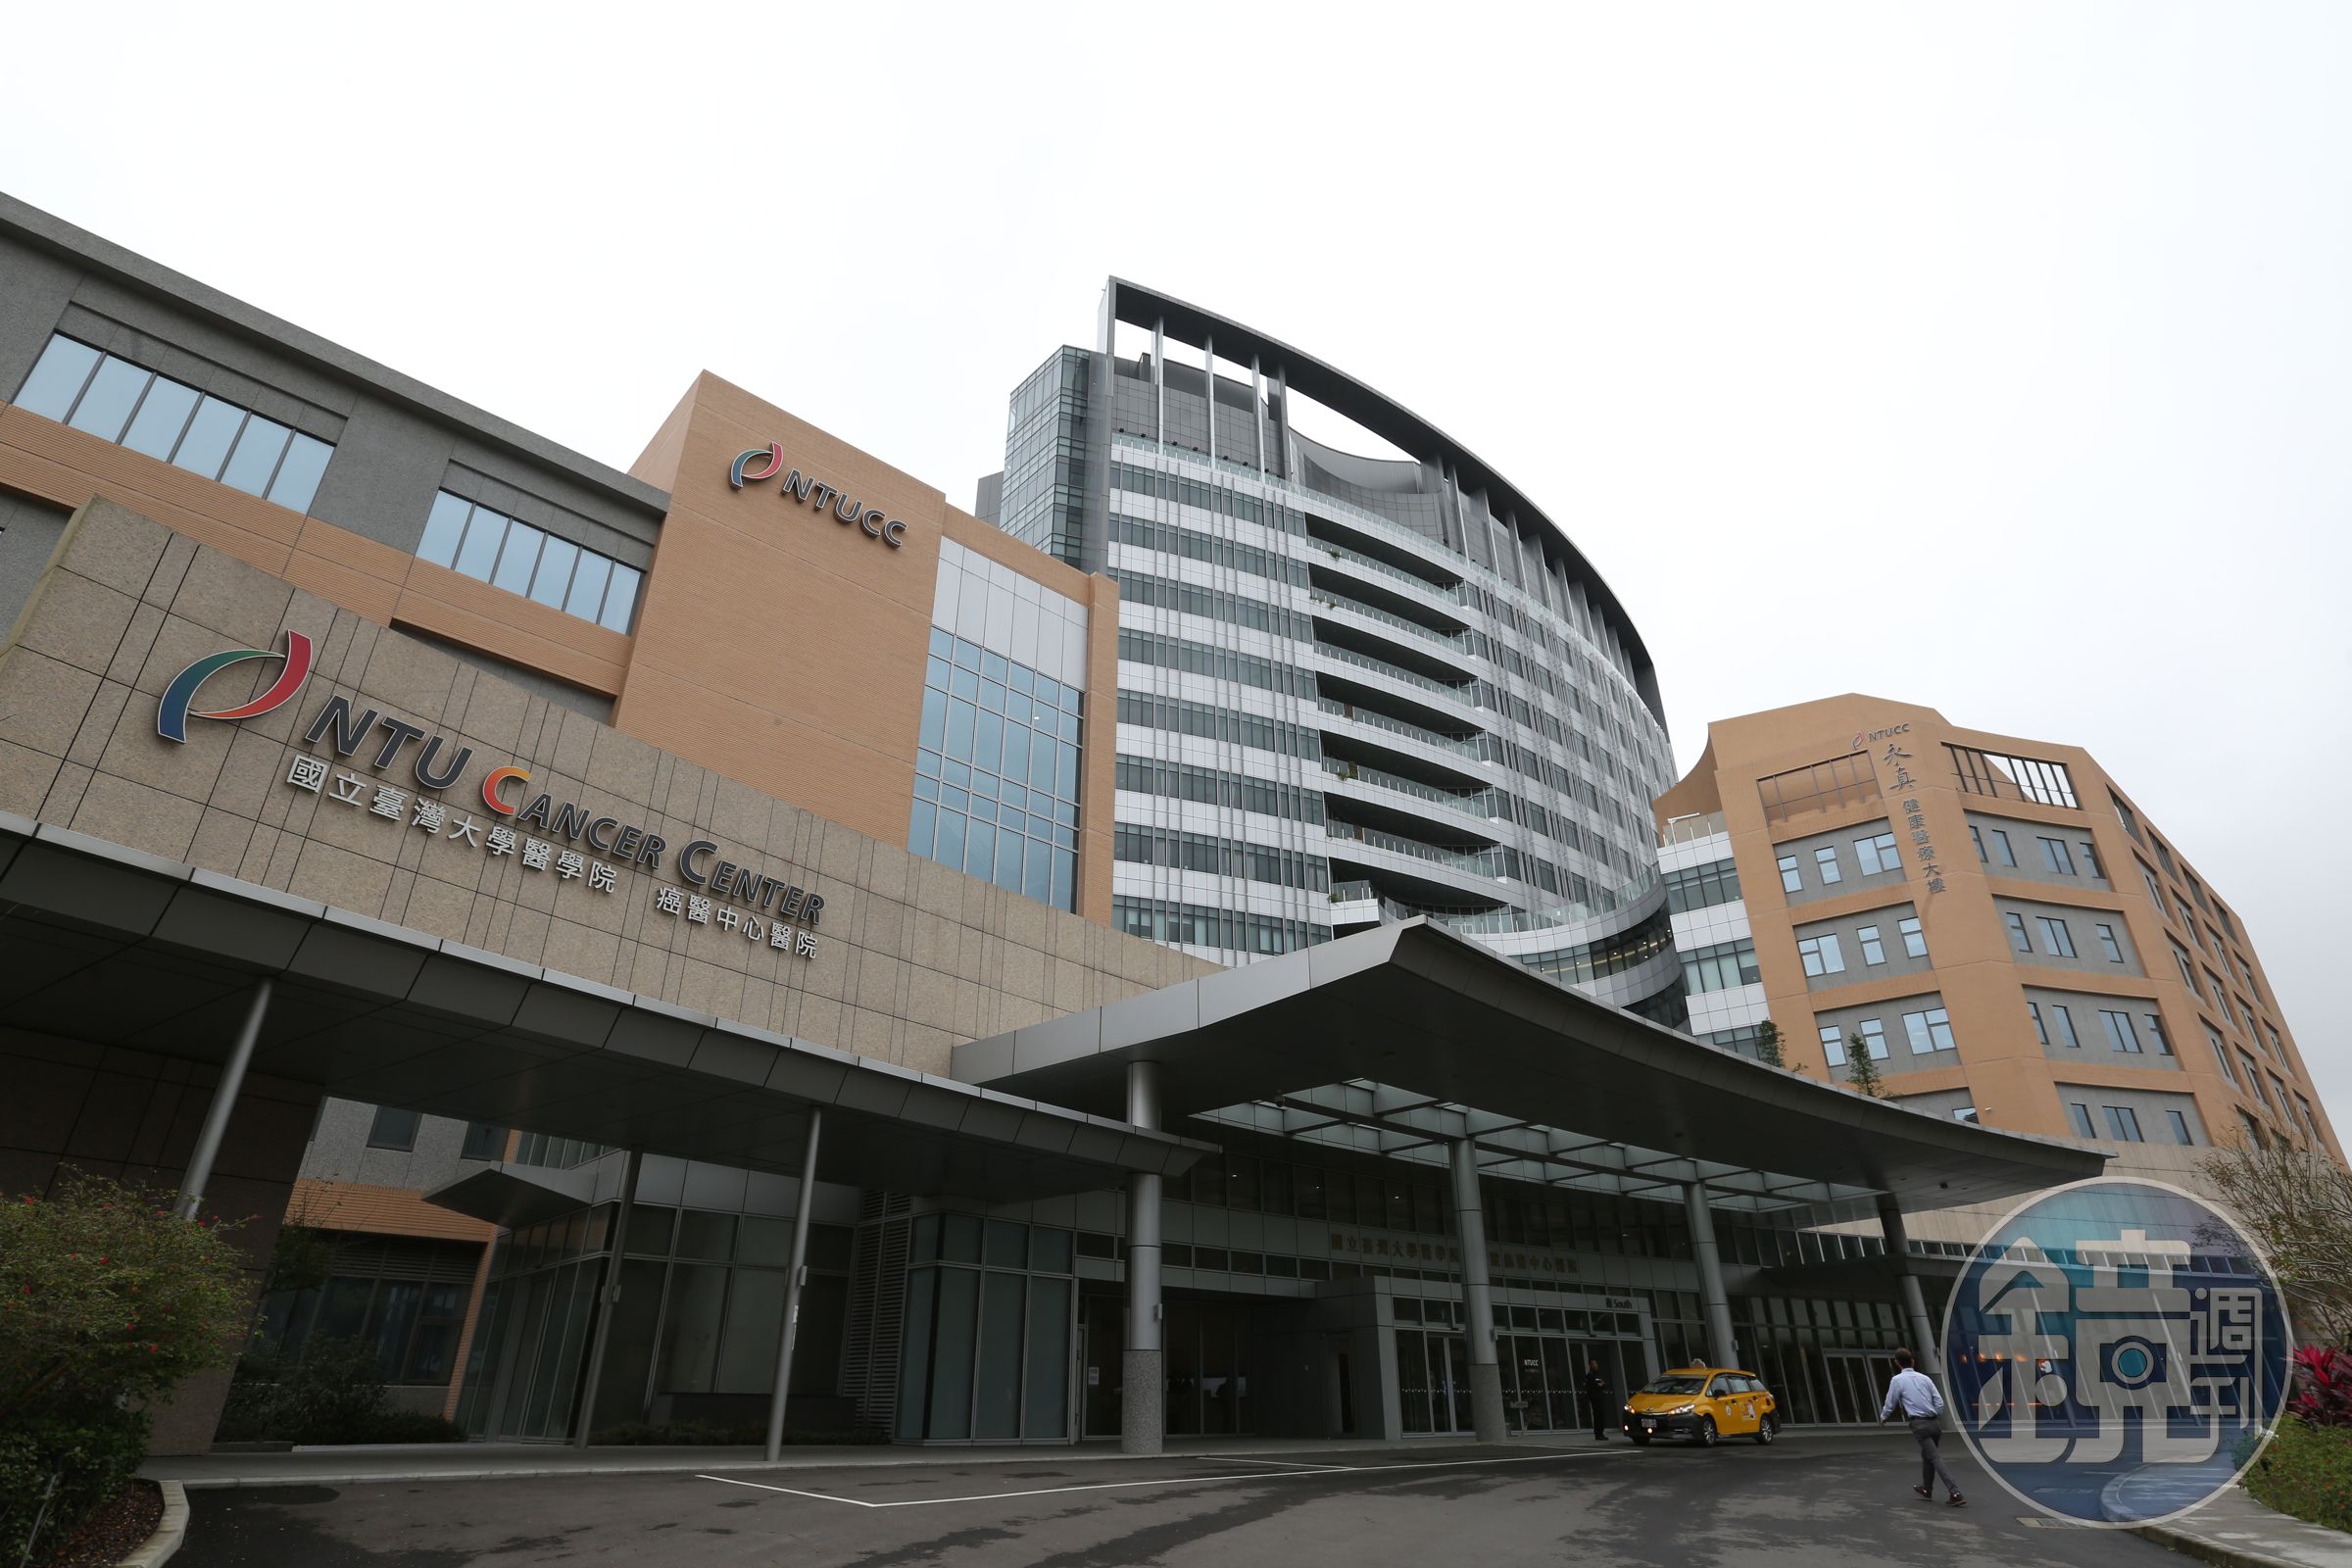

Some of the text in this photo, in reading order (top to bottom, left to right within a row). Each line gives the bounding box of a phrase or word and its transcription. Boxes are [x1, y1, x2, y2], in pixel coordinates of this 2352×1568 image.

[781, 468, 908, 549] NTUCC
[1868, 722, 1911, 743] NTUCC
[286, 754, 819, 959] 國立臺灣大學醫學院 癌醫中心醫院
[305, 694, 826, 925] NTU CANCER CENTER
